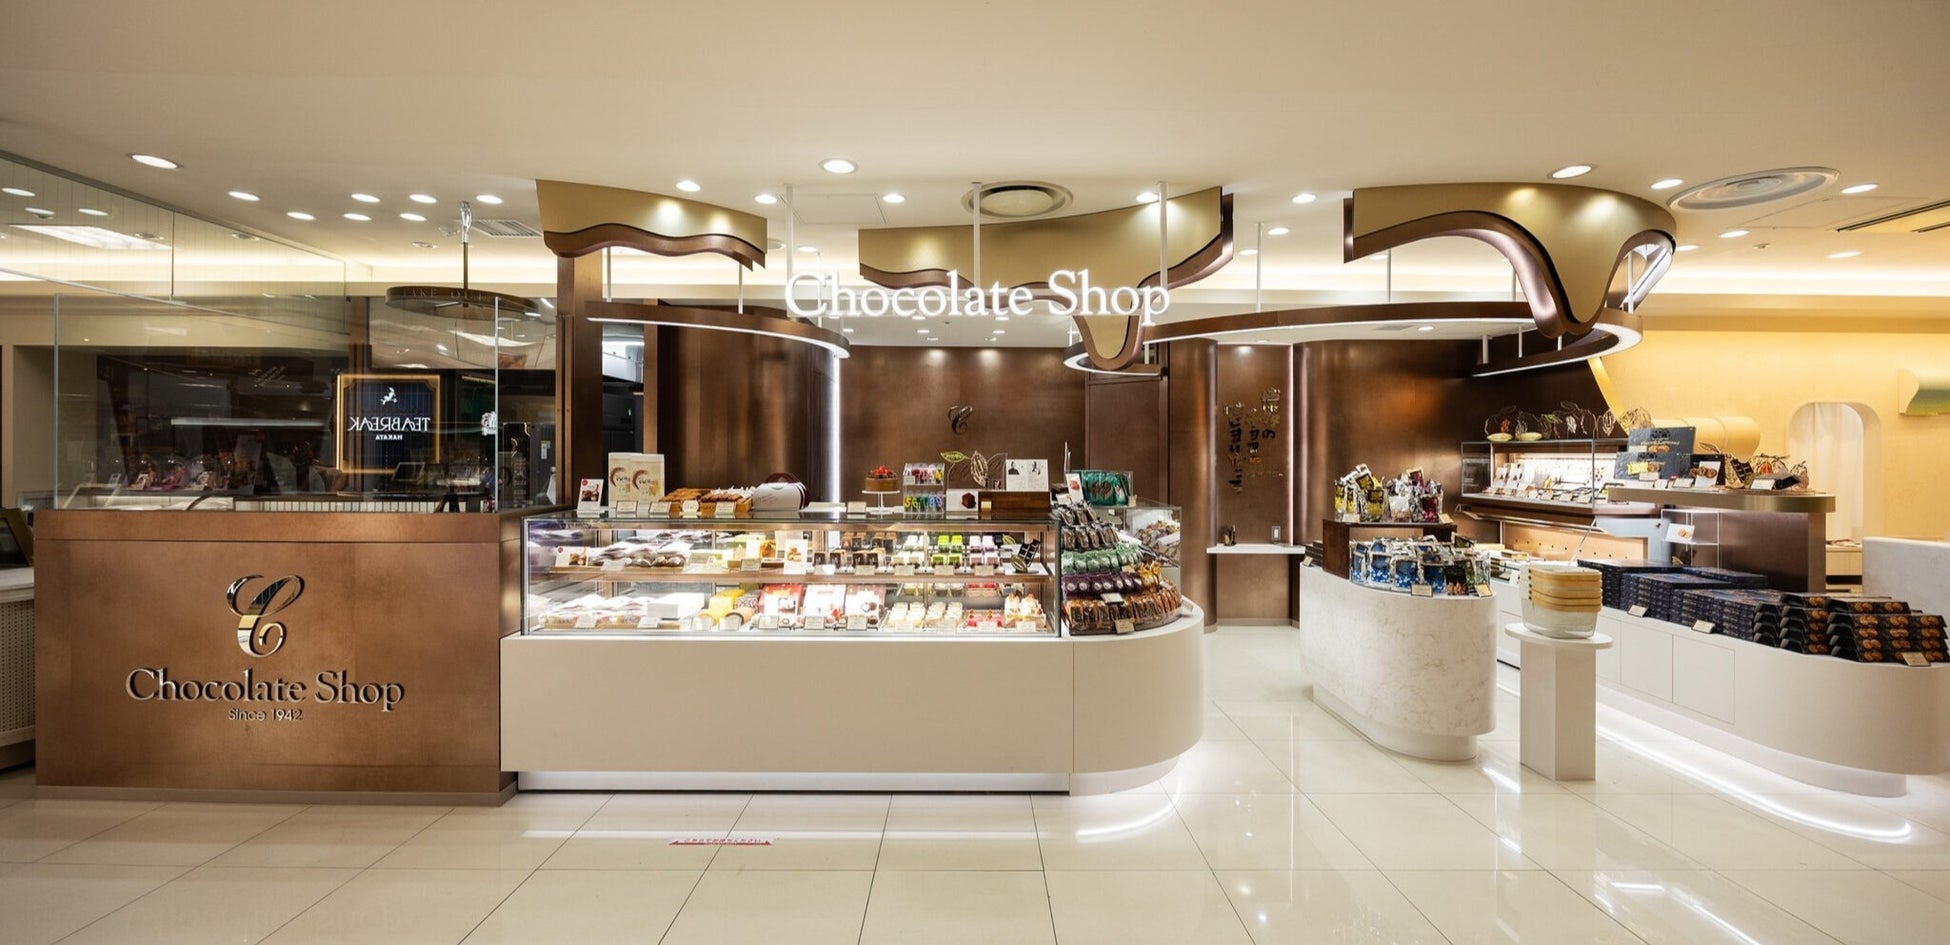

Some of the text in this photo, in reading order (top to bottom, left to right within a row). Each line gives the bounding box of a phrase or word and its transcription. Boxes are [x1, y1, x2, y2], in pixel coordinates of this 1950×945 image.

[784, 268, 1171, 327] Chocolate Shop
[125, 668, 406, 713] Chocolate Shop
[228, 708, 303, 721] Since 1942
